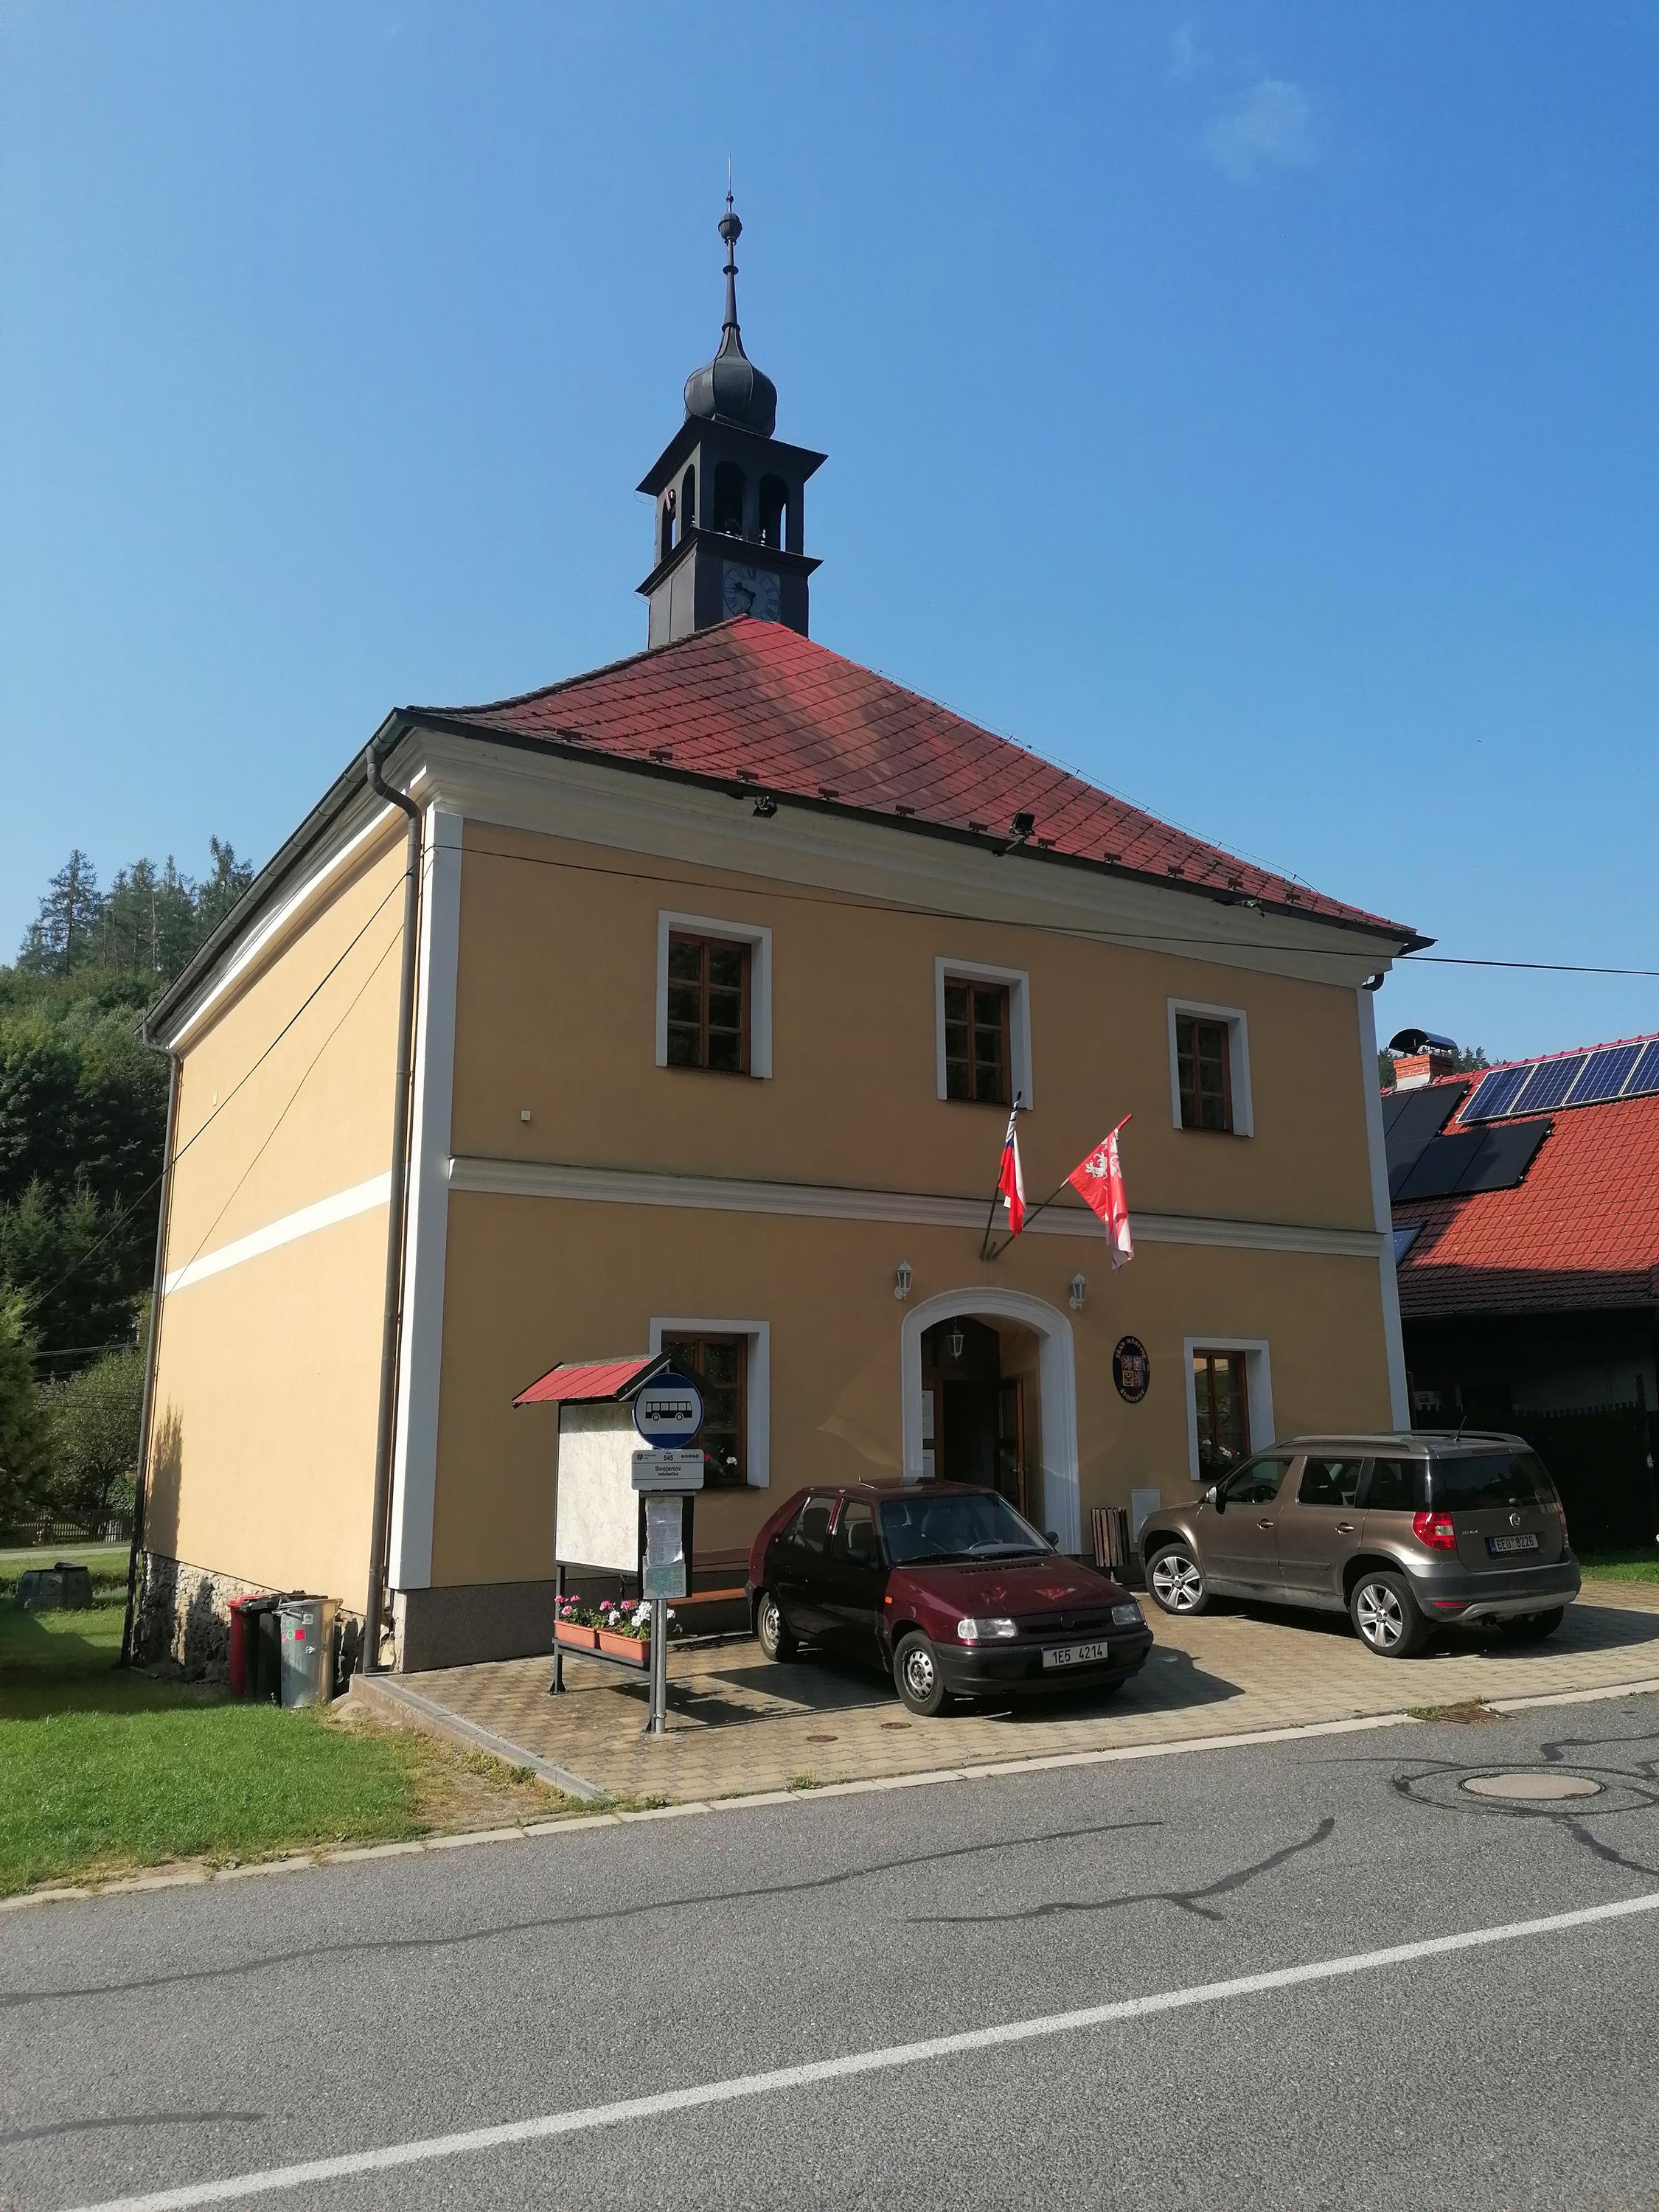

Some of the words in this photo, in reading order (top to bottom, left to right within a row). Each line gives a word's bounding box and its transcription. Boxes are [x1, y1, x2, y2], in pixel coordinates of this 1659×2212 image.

[1496, 1538, 1512, 1550] 6E0
[1515, 1535, 1534, 1548] 8226
[1052, 1649, 1071, 1664] 1E5
[1078, 1644, 1103, 1660] 4214
